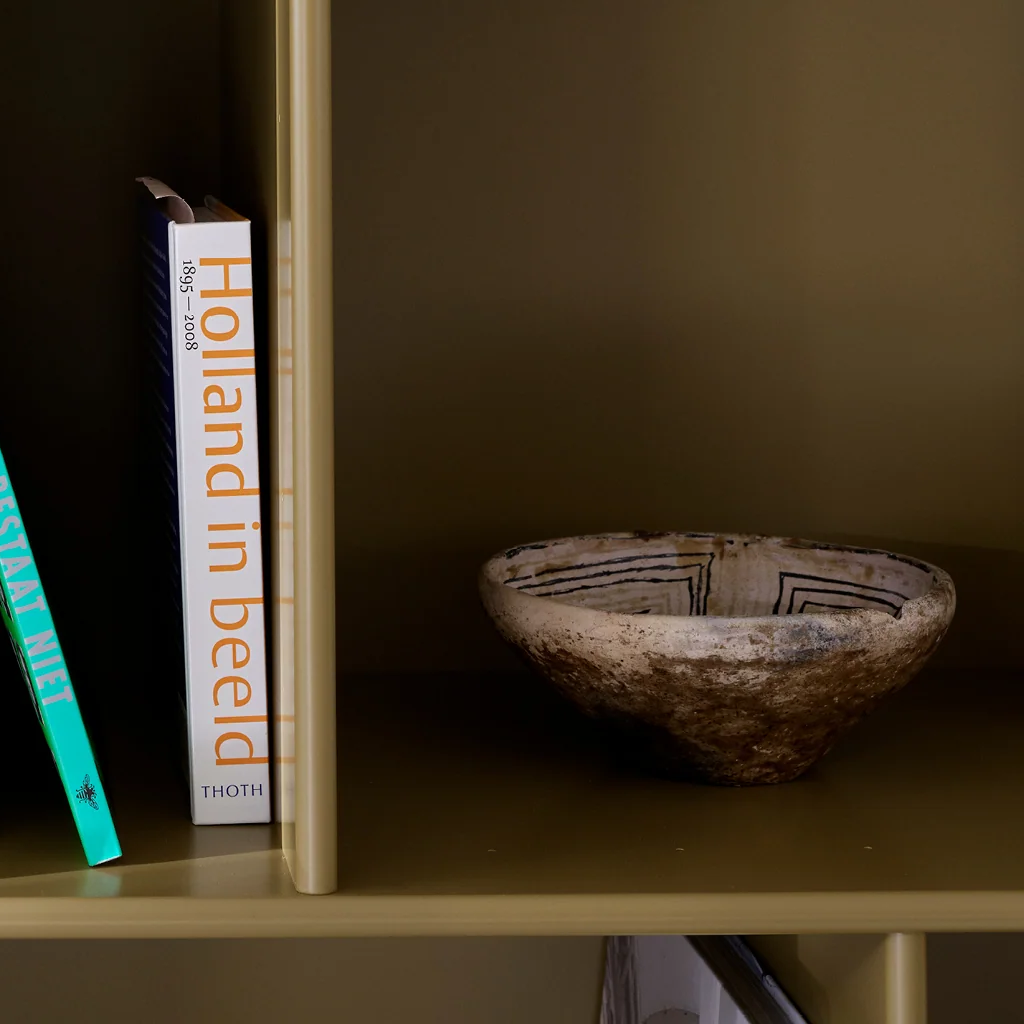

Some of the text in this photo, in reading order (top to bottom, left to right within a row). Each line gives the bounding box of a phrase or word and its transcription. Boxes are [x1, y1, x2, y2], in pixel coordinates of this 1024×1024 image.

[179, 259, 197, 293] 1895
[184, 314, 199, 351] 2008
[199, 257, 268, 766] Holland in beeld
[24, 631, 73, 707] NIET
[201, 783, 263, 798] THOTH
